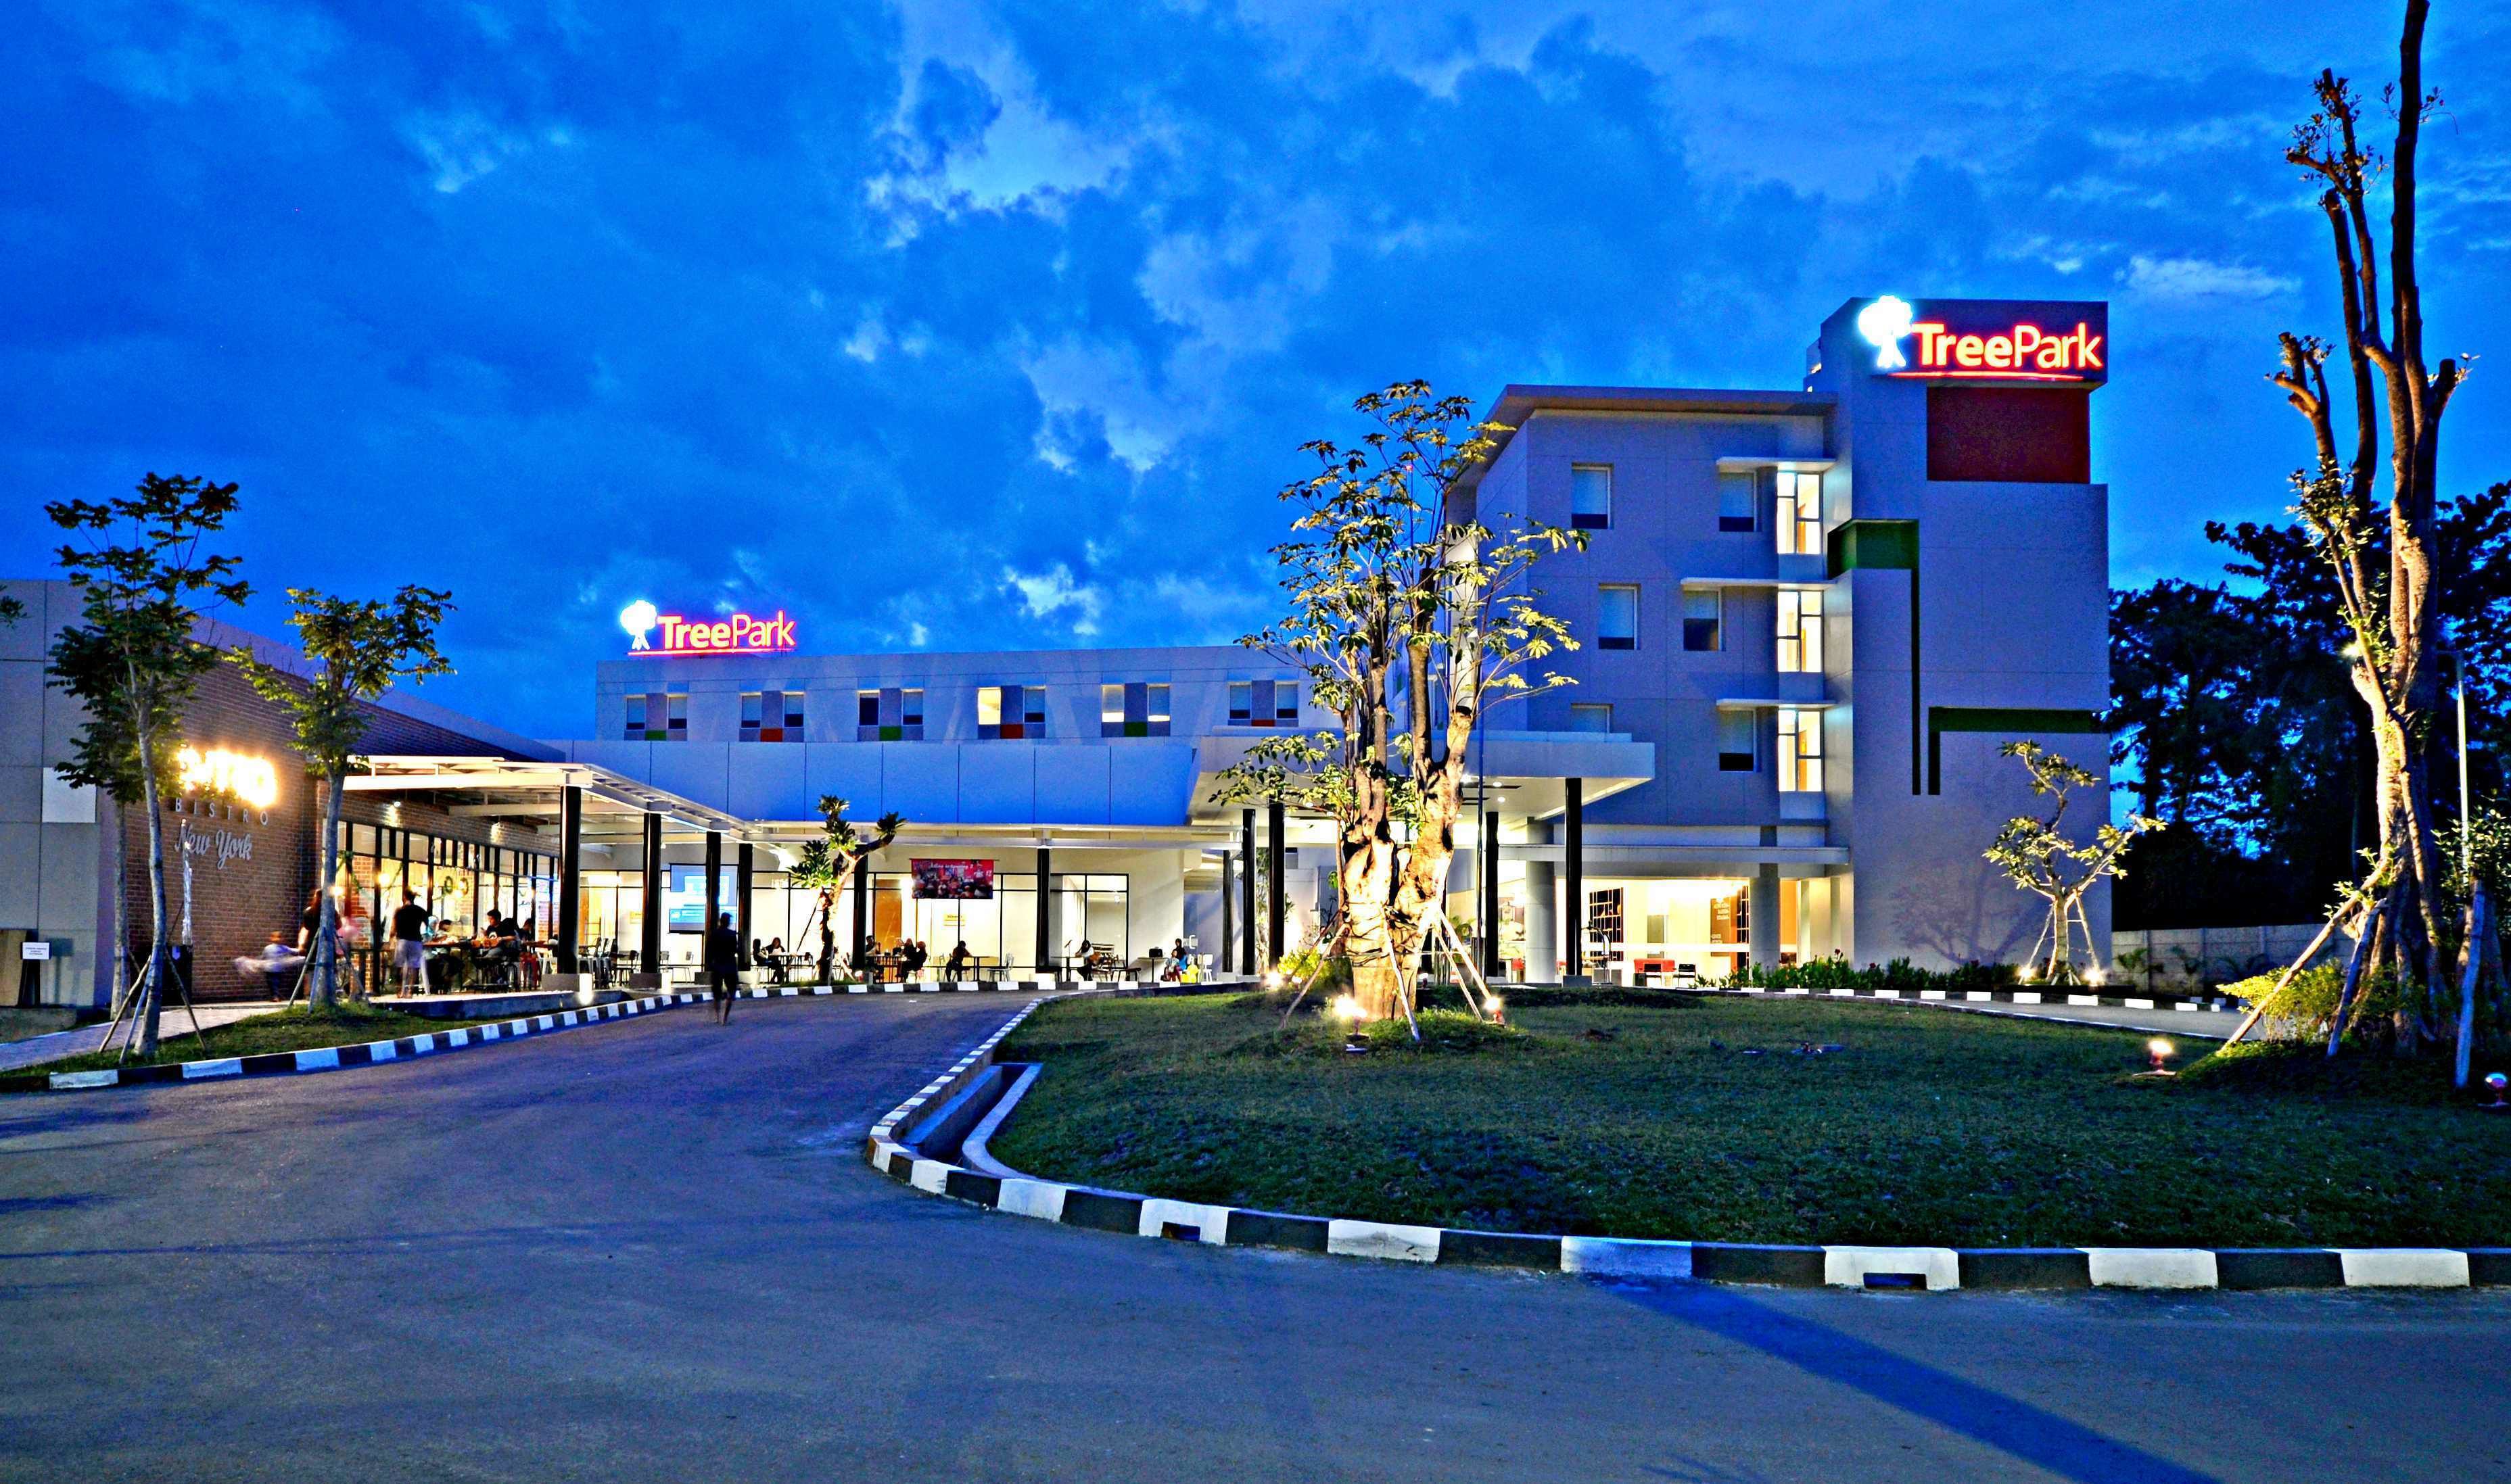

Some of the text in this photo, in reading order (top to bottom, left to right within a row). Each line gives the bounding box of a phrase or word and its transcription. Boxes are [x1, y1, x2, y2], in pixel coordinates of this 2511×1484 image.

[1911, 321, 2103, 368] TreePark
[657, 610, 796, 649] TreePark
[175, 797, 268, 826] BISTRO
[174, 823, 253, 870] New York
